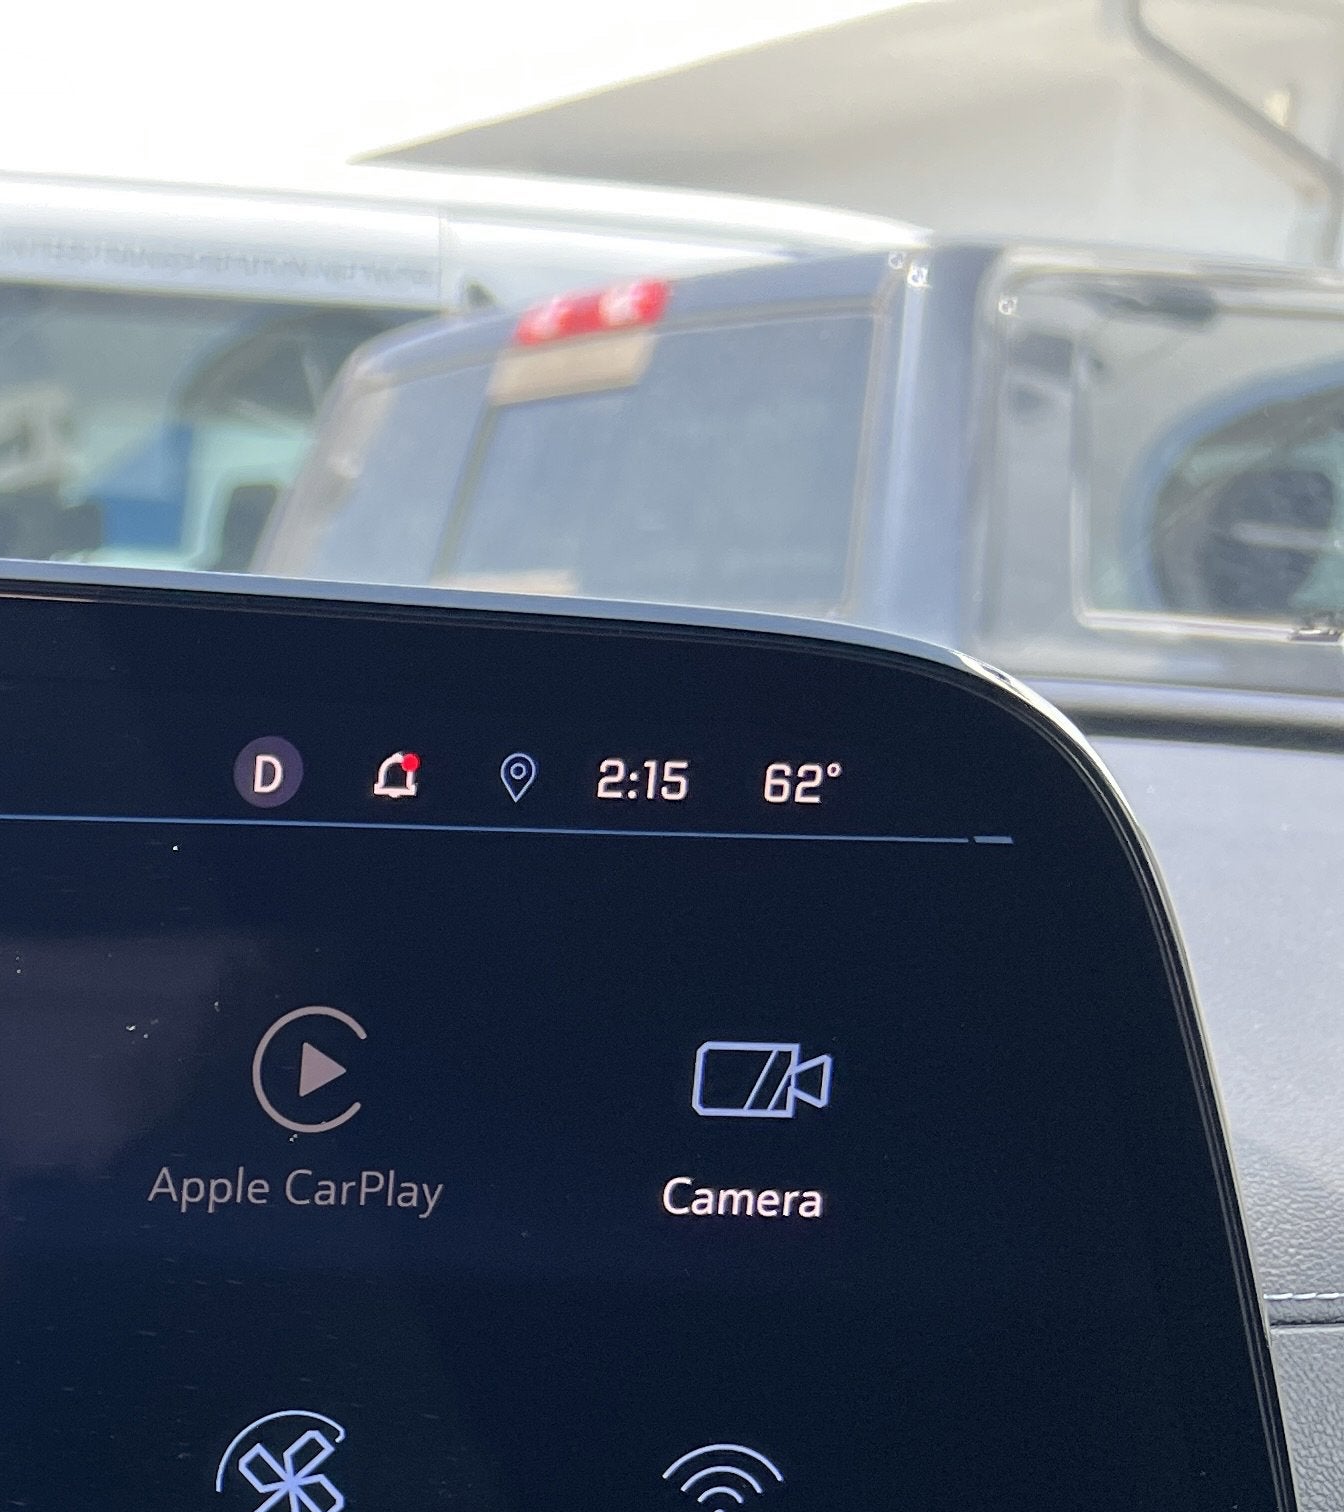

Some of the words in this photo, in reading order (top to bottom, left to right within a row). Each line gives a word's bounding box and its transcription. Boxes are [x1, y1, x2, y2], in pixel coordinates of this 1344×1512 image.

[252, 754, 284, 794] D
[596, 758, 689, 801] 2:15
[763, 761, 843, 805] 62°
[146, 1165, 271, 1215] Apple
[284, 1168, 444, 1220] CarPlay
[662, 1175, 823, 1219] Camera
